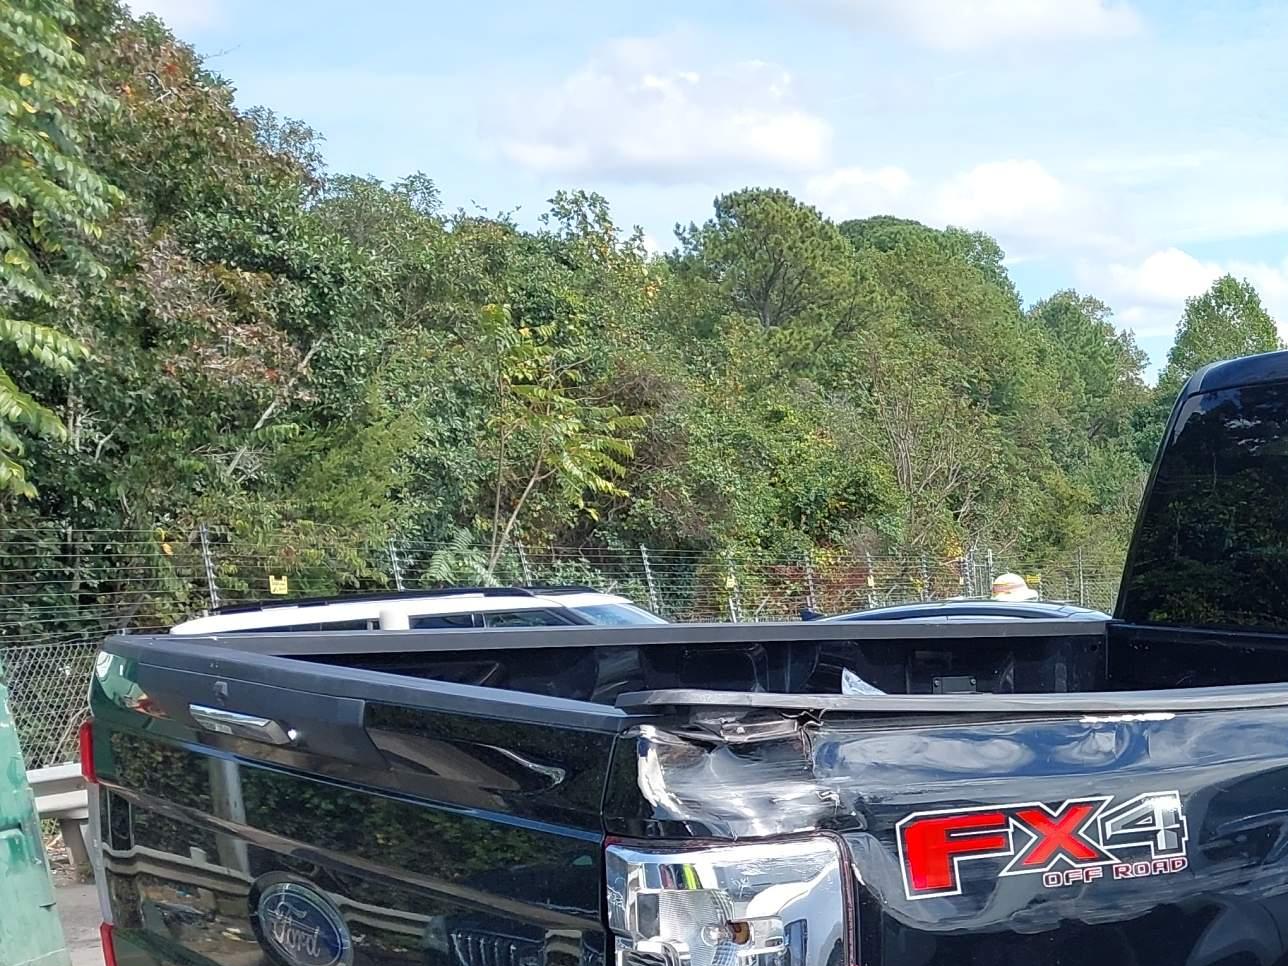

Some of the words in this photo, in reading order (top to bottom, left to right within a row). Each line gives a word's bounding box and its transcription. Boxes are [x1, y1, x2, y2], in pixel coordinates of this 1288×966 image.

[896, 789, 1188, 901] FX4
[1043, 866, 1103, 888] OFF
[1112, 856, 1188, 880] ROAD
